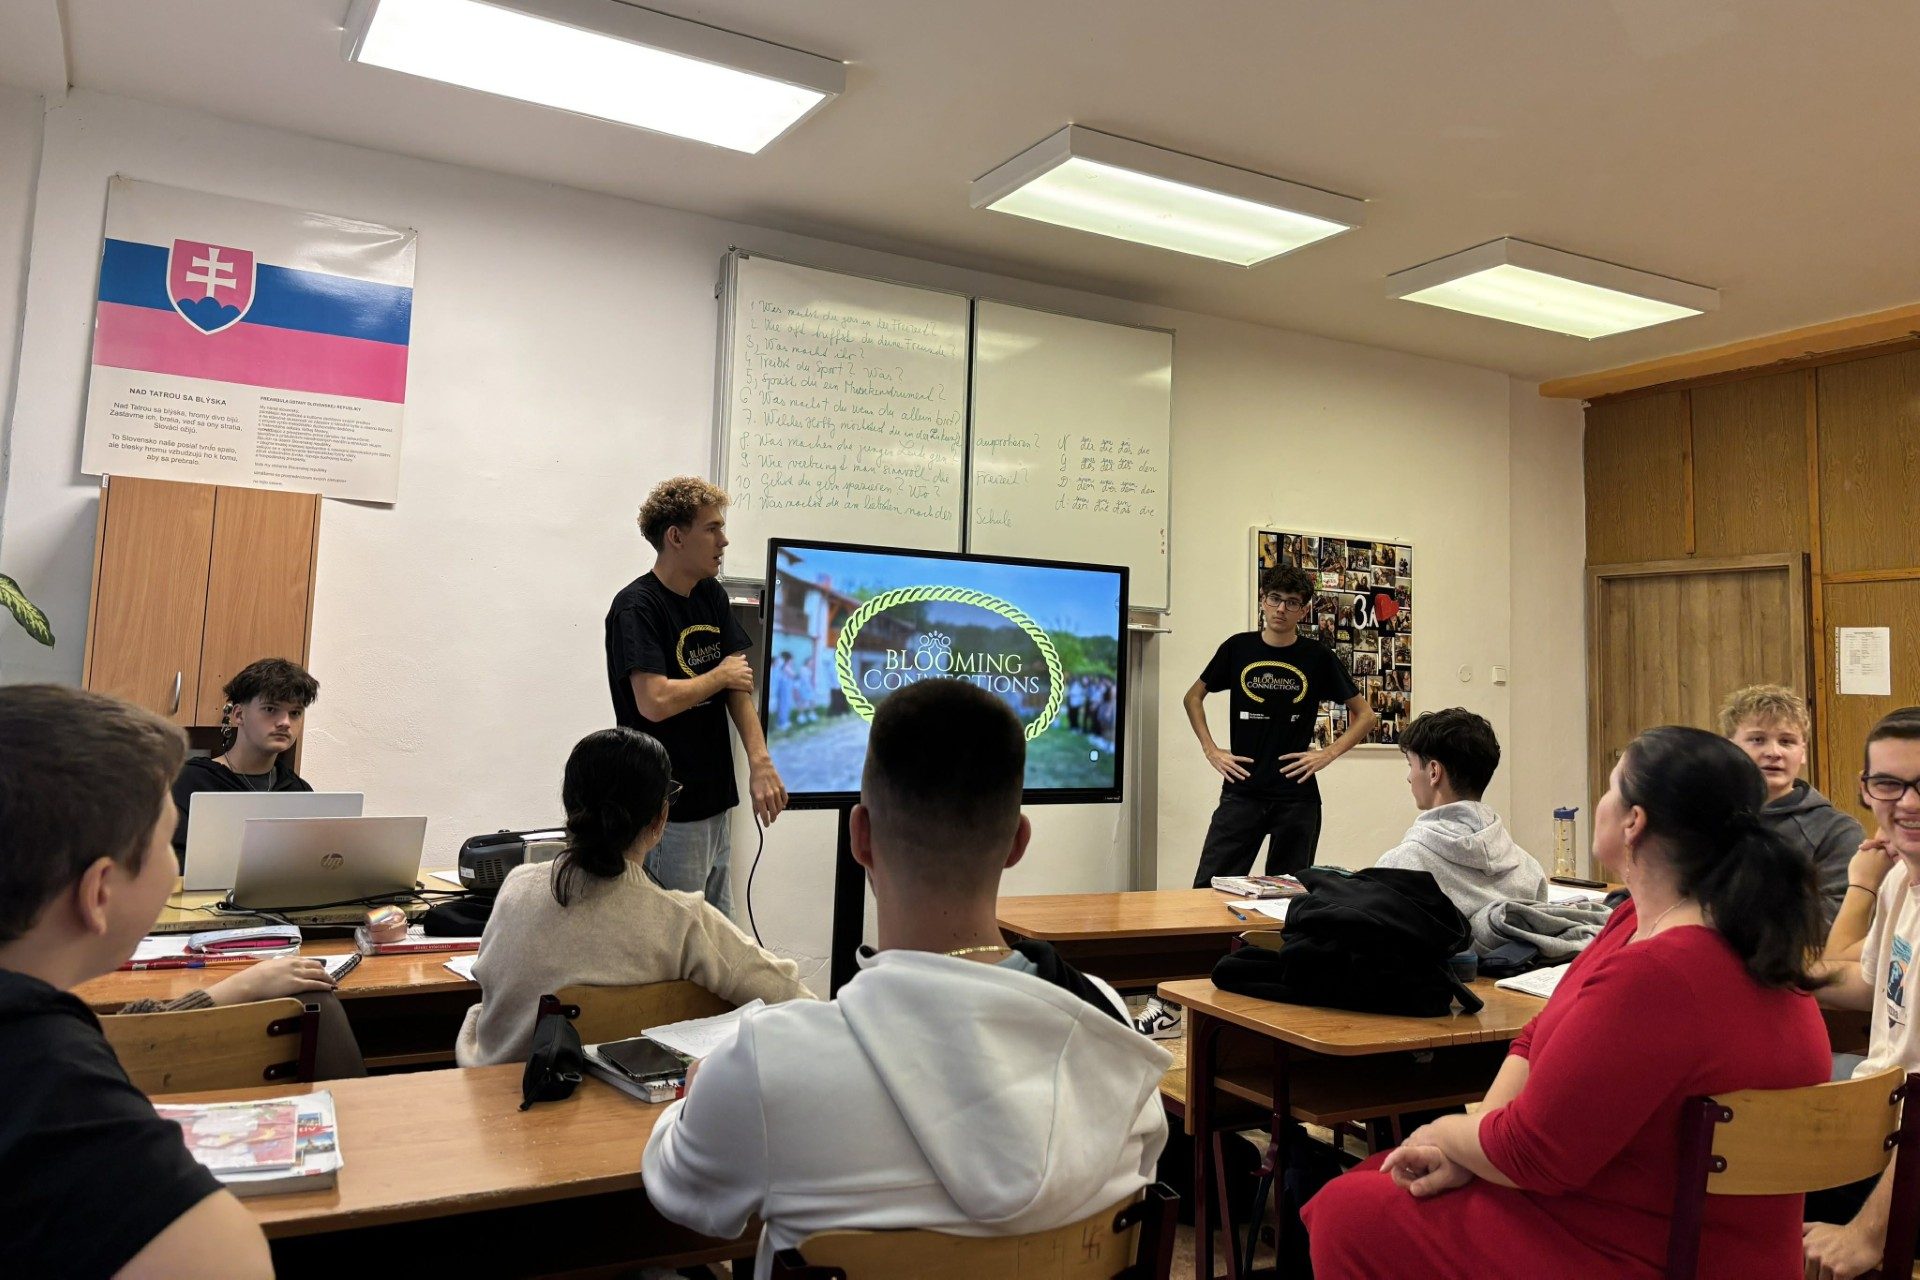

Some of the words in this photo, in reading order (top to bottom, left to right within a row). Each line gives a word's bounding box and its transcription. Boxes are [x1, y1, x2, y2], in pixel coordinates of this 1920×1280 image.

[758, 300, 782, 314] Was
[822, 310, 838, 321] du
[764, 318, 780, 333] Wie
[788, 320, 806, 338] oft
[862, 332, 874, 344] du
[878, 334, 904, 348] deine
[764, 337, 788, 352] Was
[796, 361, 810, 372] du
[800, 376, 817, 387] du
[823, 382, 838, 391] ein
[150, 390, 180, 400] TATROU
[196, 396, 227, 406] BLÝSKA
[758, 390, 785, 406] Was
[834, 400, 846, 412] du
[878, 402, 894, 418] du
[901, 406, 932, 422] allein
[109, 409, 144, 420] Zastavme
[160, 416, 181, 424] bratia,
[114, 402, 128, 410] Nad
[130, 404, 152, 412] Tatrou
[189, 411, 210, 420] hromy
[212, 414, 225, 422] divo
[154, 422, 178, 431] Slováci
[806, 416, 836, 439] Hobby
[889, 426, 900, 436] du
[121, 443, 143, 452] blesky
[145, 446, 167, 454] hromu
[122, 434, 157, 445] Slovensko
[159, 439, 176, 447] naše
[754, 433, 782, 447] Was
[788, 434, 832, 449] machen
[147, 454, 159, 462] aby
[1138, 445, 1150, 456] die
[758, 454, 782, 468] Wie
[852, 464, 876, 474] man
[933, 469, 950, 484] die
[736, 475, 751, 490] 10
[798, 473, 811, 486] du
[976, 508, 1012, 527] Schule
[1139, 505, 1155, 516] die
[886, 649, 1022, 674] BLOOMING
[864, 669, 1040, 694] CONTIONS
[1247, 681, 1300, 691] CONNECTIONS
[1253, 676, 1296, 685] BLOOMING
[320, 852, 344, 870] hp
